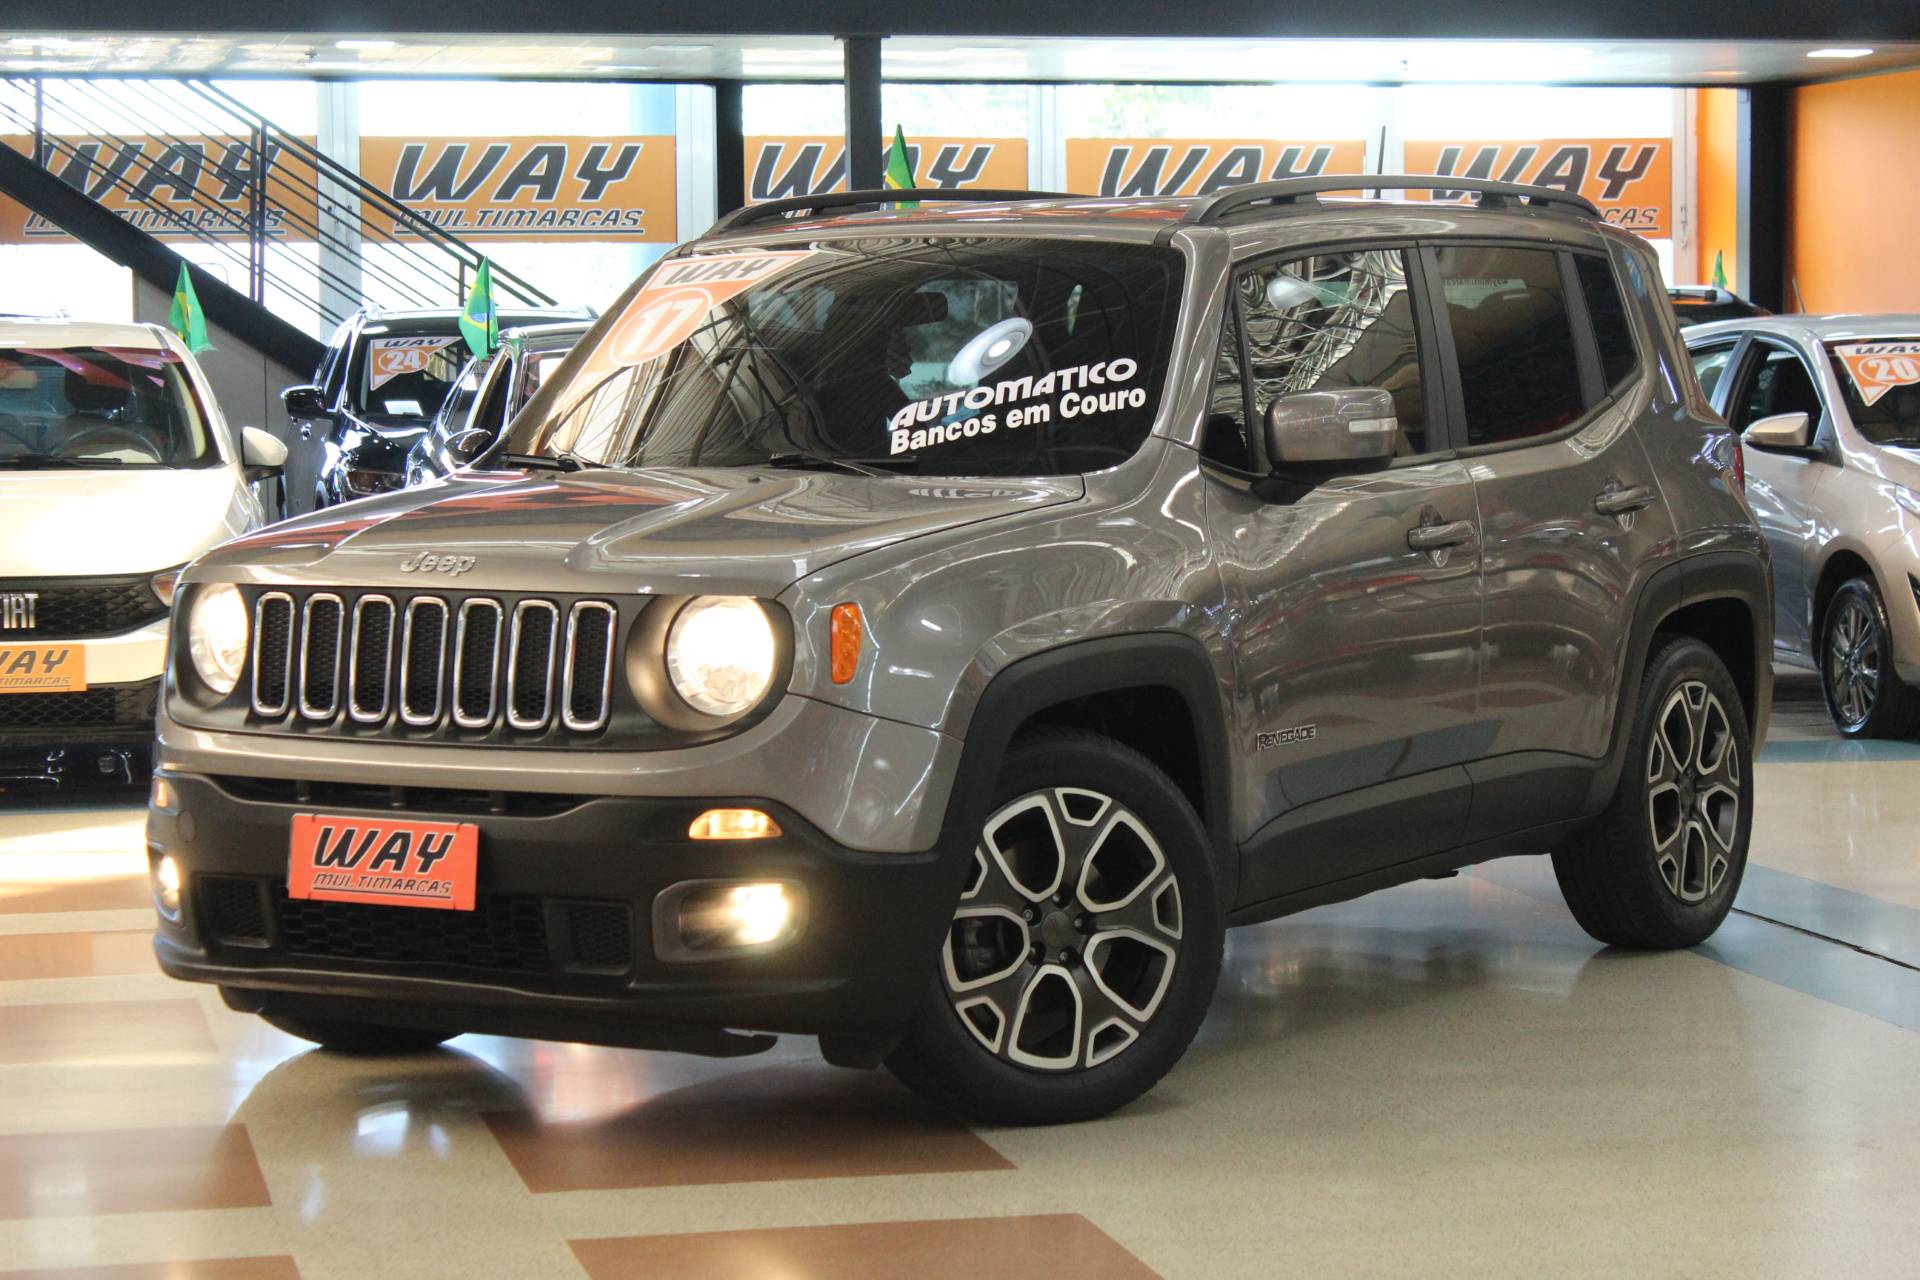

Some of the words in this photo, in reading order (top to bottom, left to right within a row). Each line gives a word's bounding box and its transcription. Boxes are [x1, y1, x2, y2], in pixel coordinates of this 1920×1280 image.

[35, 143, 281, 202] WAY
[391, 143, 644, 202] WAY
[750, 143, 996, 202] WY
[1098, 144, 1335, 197] WAY
[1429, 145, 1660, 202] WAY
[664, 258, 776, 286] WAY
[384, 338, 443, 348] WAY
[614, 298, 705, 358] 17
[387, 351, 421, 370] 24
[1867, 358, 1920, 381] 20
[888, 357, 1138, 432] AUTOMATICO
[890, 414, 997, 456] Bancos
[1005, 402, 1051, 429] em
[1058, 387, 1147, 419] Couro
[400, 551, 477, 577] Jeep
[0, 593, 40, 629] IAT
[0, 649, 70, 675] AY
[1256, 724, 1316, 751] RENEGADE
[312, 826, 456, 875] WAY
[313, 873, 453, 894] MULTIMARCAS
